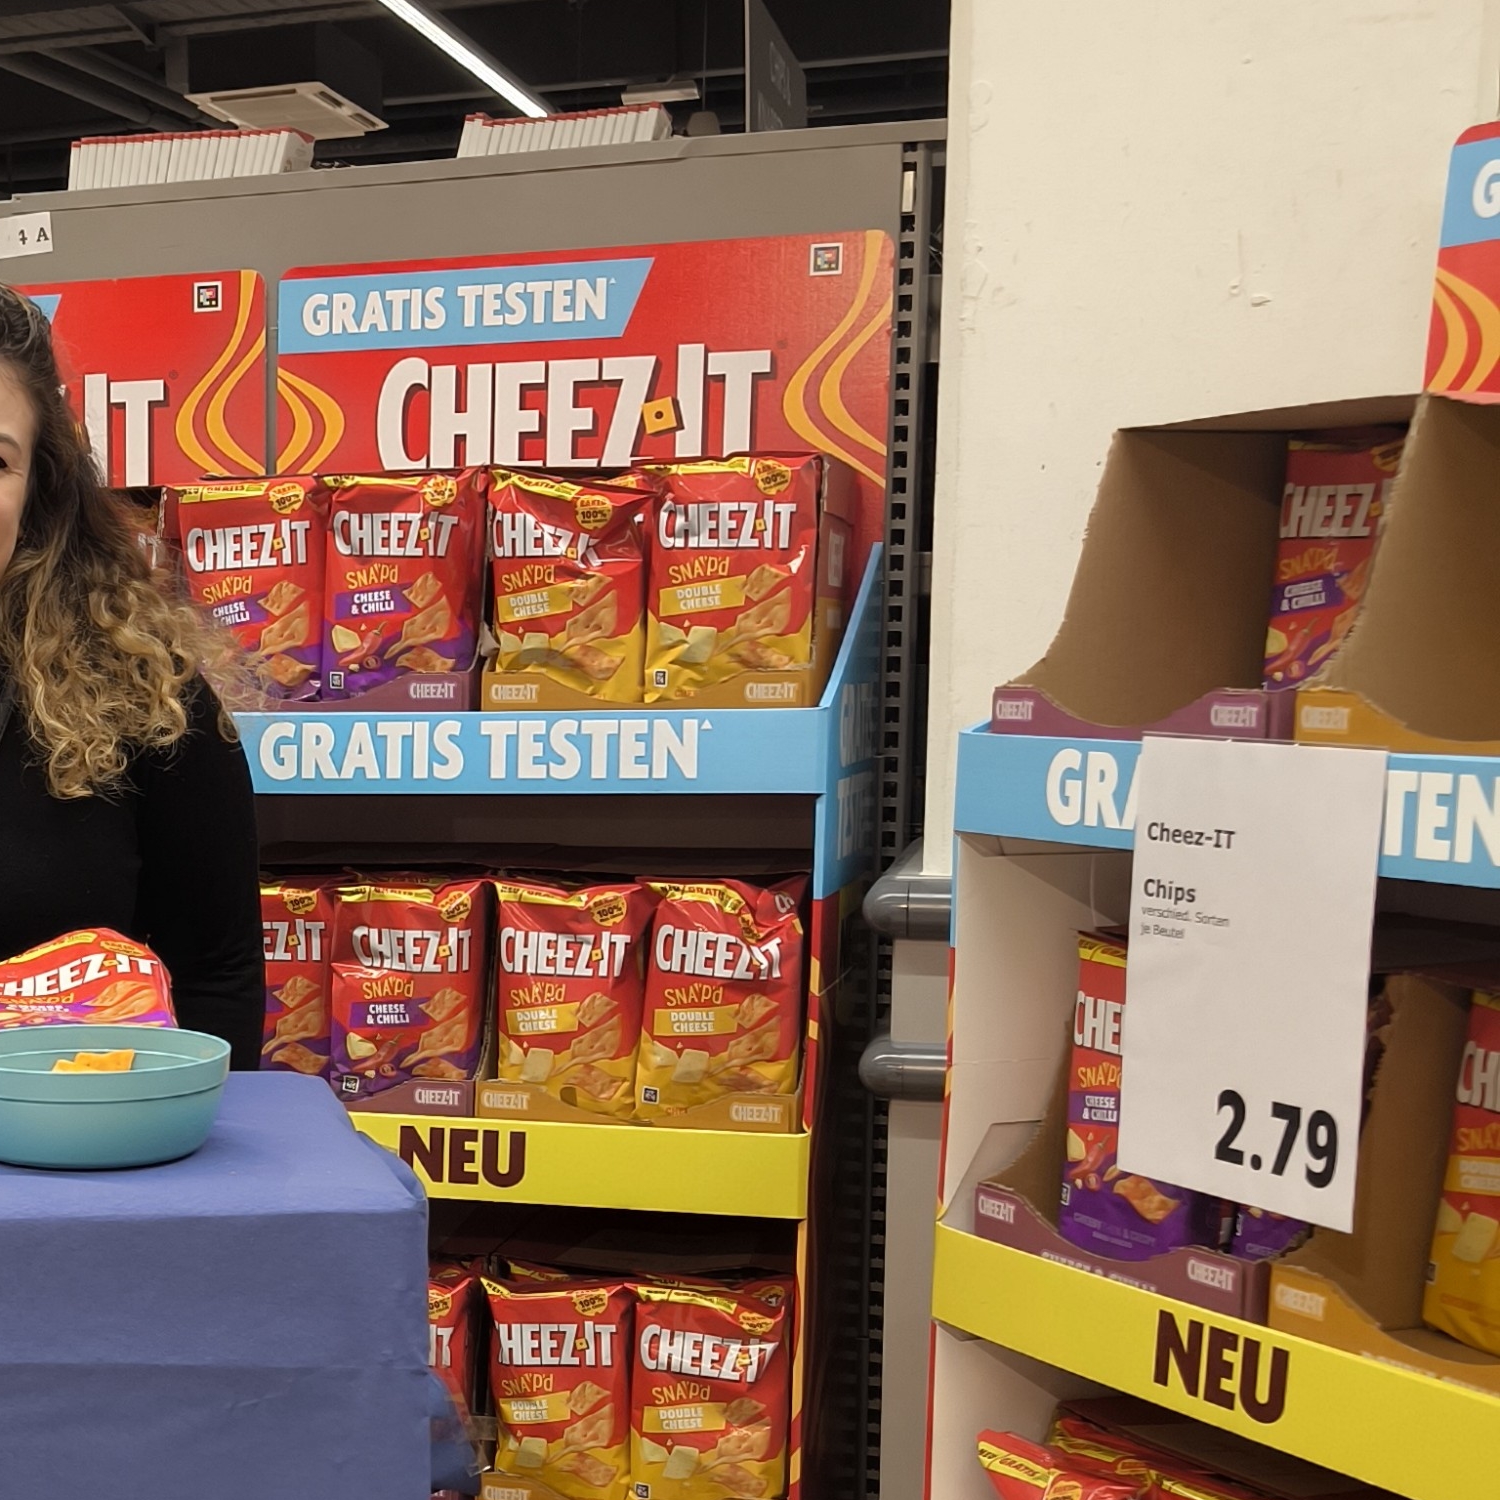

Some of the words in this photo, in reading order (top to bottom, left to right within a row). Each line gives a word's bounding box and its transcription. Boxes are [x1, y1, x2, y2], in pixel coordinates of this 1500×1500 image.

[36, 227, 50, 243] A
[302, 285, 446, 337] GRATIS
[457, 277, 606, 328] TESTEN
[353, 589, 392, 603] CHEESE
[509, 591, 550, 608] DOUBLE
[676, 584, 722, 601] DOUBLE
[212, 602, 246, 618] CHEESE
[350, 604, 360, 615] &
[361, 600, 395, 614] CHILLI
[513, 603, 551, 618] CHEESE
[679, 595, 722, 611] CHEESE
[259, 719, 465, 781] GRATIS
[480, 719, 698, 780] TESTEN
[1146, 822, 1236, 850] Cheez-IT
[1143, 879, 1197, 905] Chips
[1141, 906, 1191, 923] verschied.
[1194, 912, 1230, 928] Sorten
[1140, 922, 1151, 936] je
[1153, 925, 1185, 939] Beutel
[368, 1003, 407, 1015] CHEESE
[516, 1008, 559, 1022] DOUBLE
[670, 1011, 716, 1023] DOUBLE
[366, 1015, 375, 1025] &
[376, 1013, 410, 1025] CHILLI
[518, 1019, 557, 1032] CHEESE
[672, 1021, 715, 1034] CHEESE
[1214, 1088, 1339, 1189] 2.79
[399, 1125, 527, 1188] NEU
[1153, 1309, 1290, 1425] NEU
[510, 1400, 549, 1412] DOUBLE
[658, 1407, 704, 1420] DOUBLE
[513, 1409, 549, 1421] CHEESE
[662, 1417, 704, 1430] CHEESE
[1000, 1453, 1039, 1479] GRATIS
